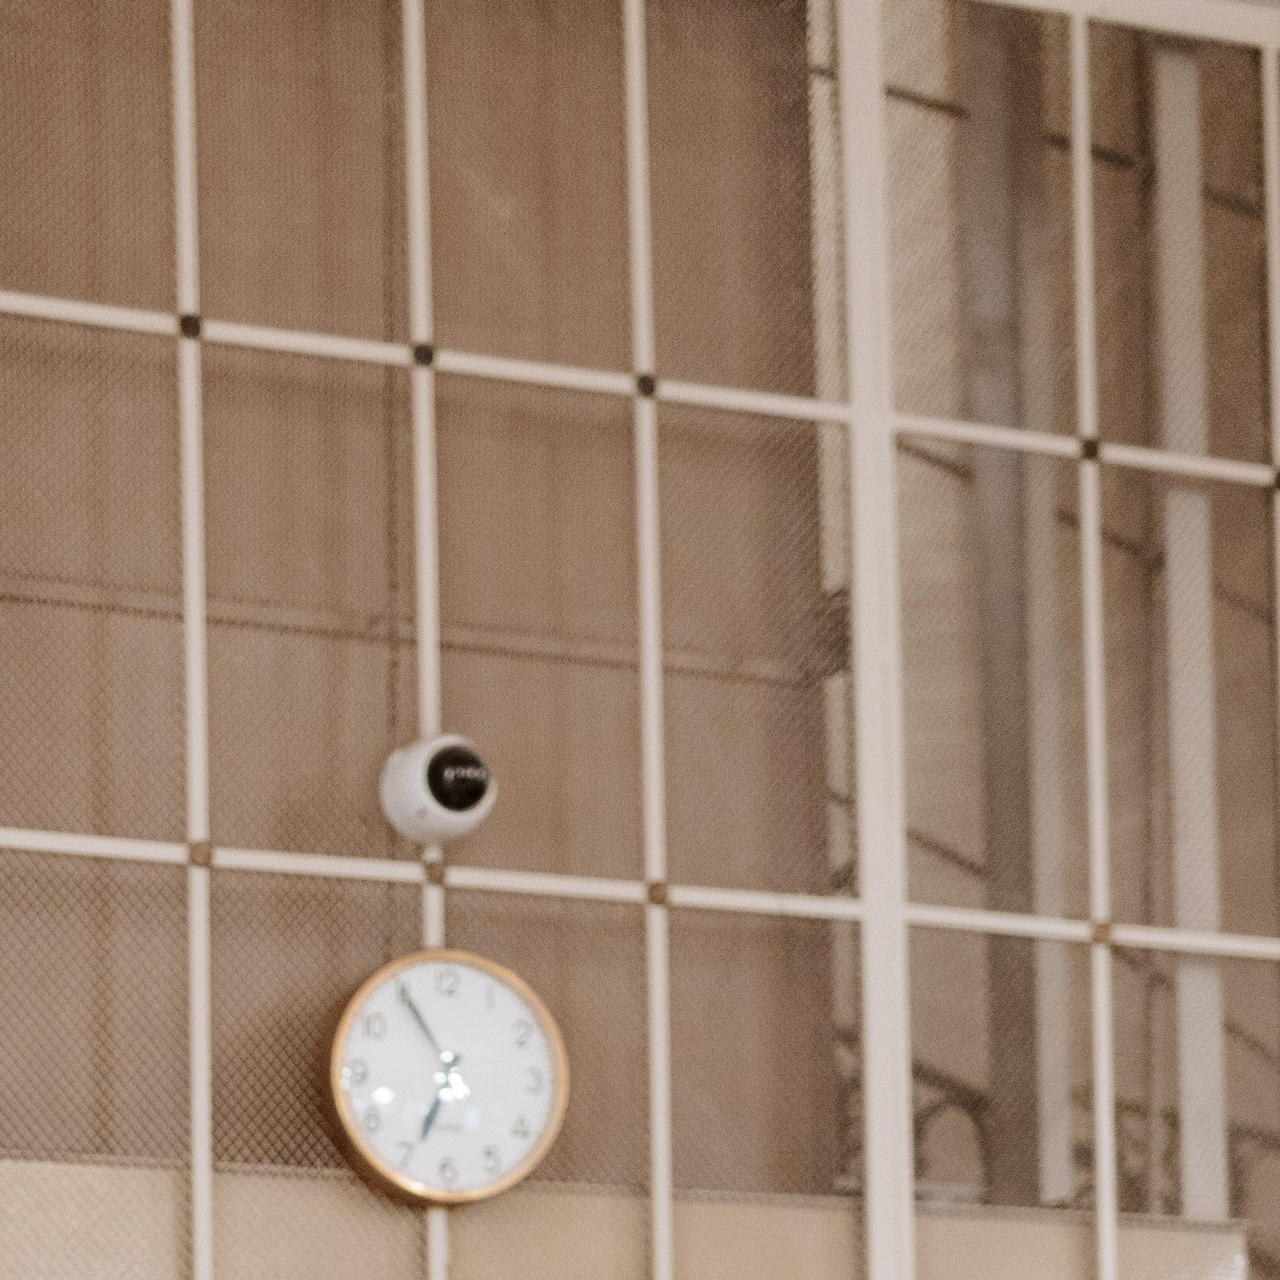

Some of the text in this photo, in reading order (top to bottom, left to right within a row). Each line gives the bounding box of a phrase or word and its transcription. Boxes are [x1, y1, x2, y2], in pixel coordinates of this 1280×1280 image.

[511, 1019, 534, 1050] 2
[523, 1065, 544, 1096] 3
[396, 1140, 415, 1170] 7
